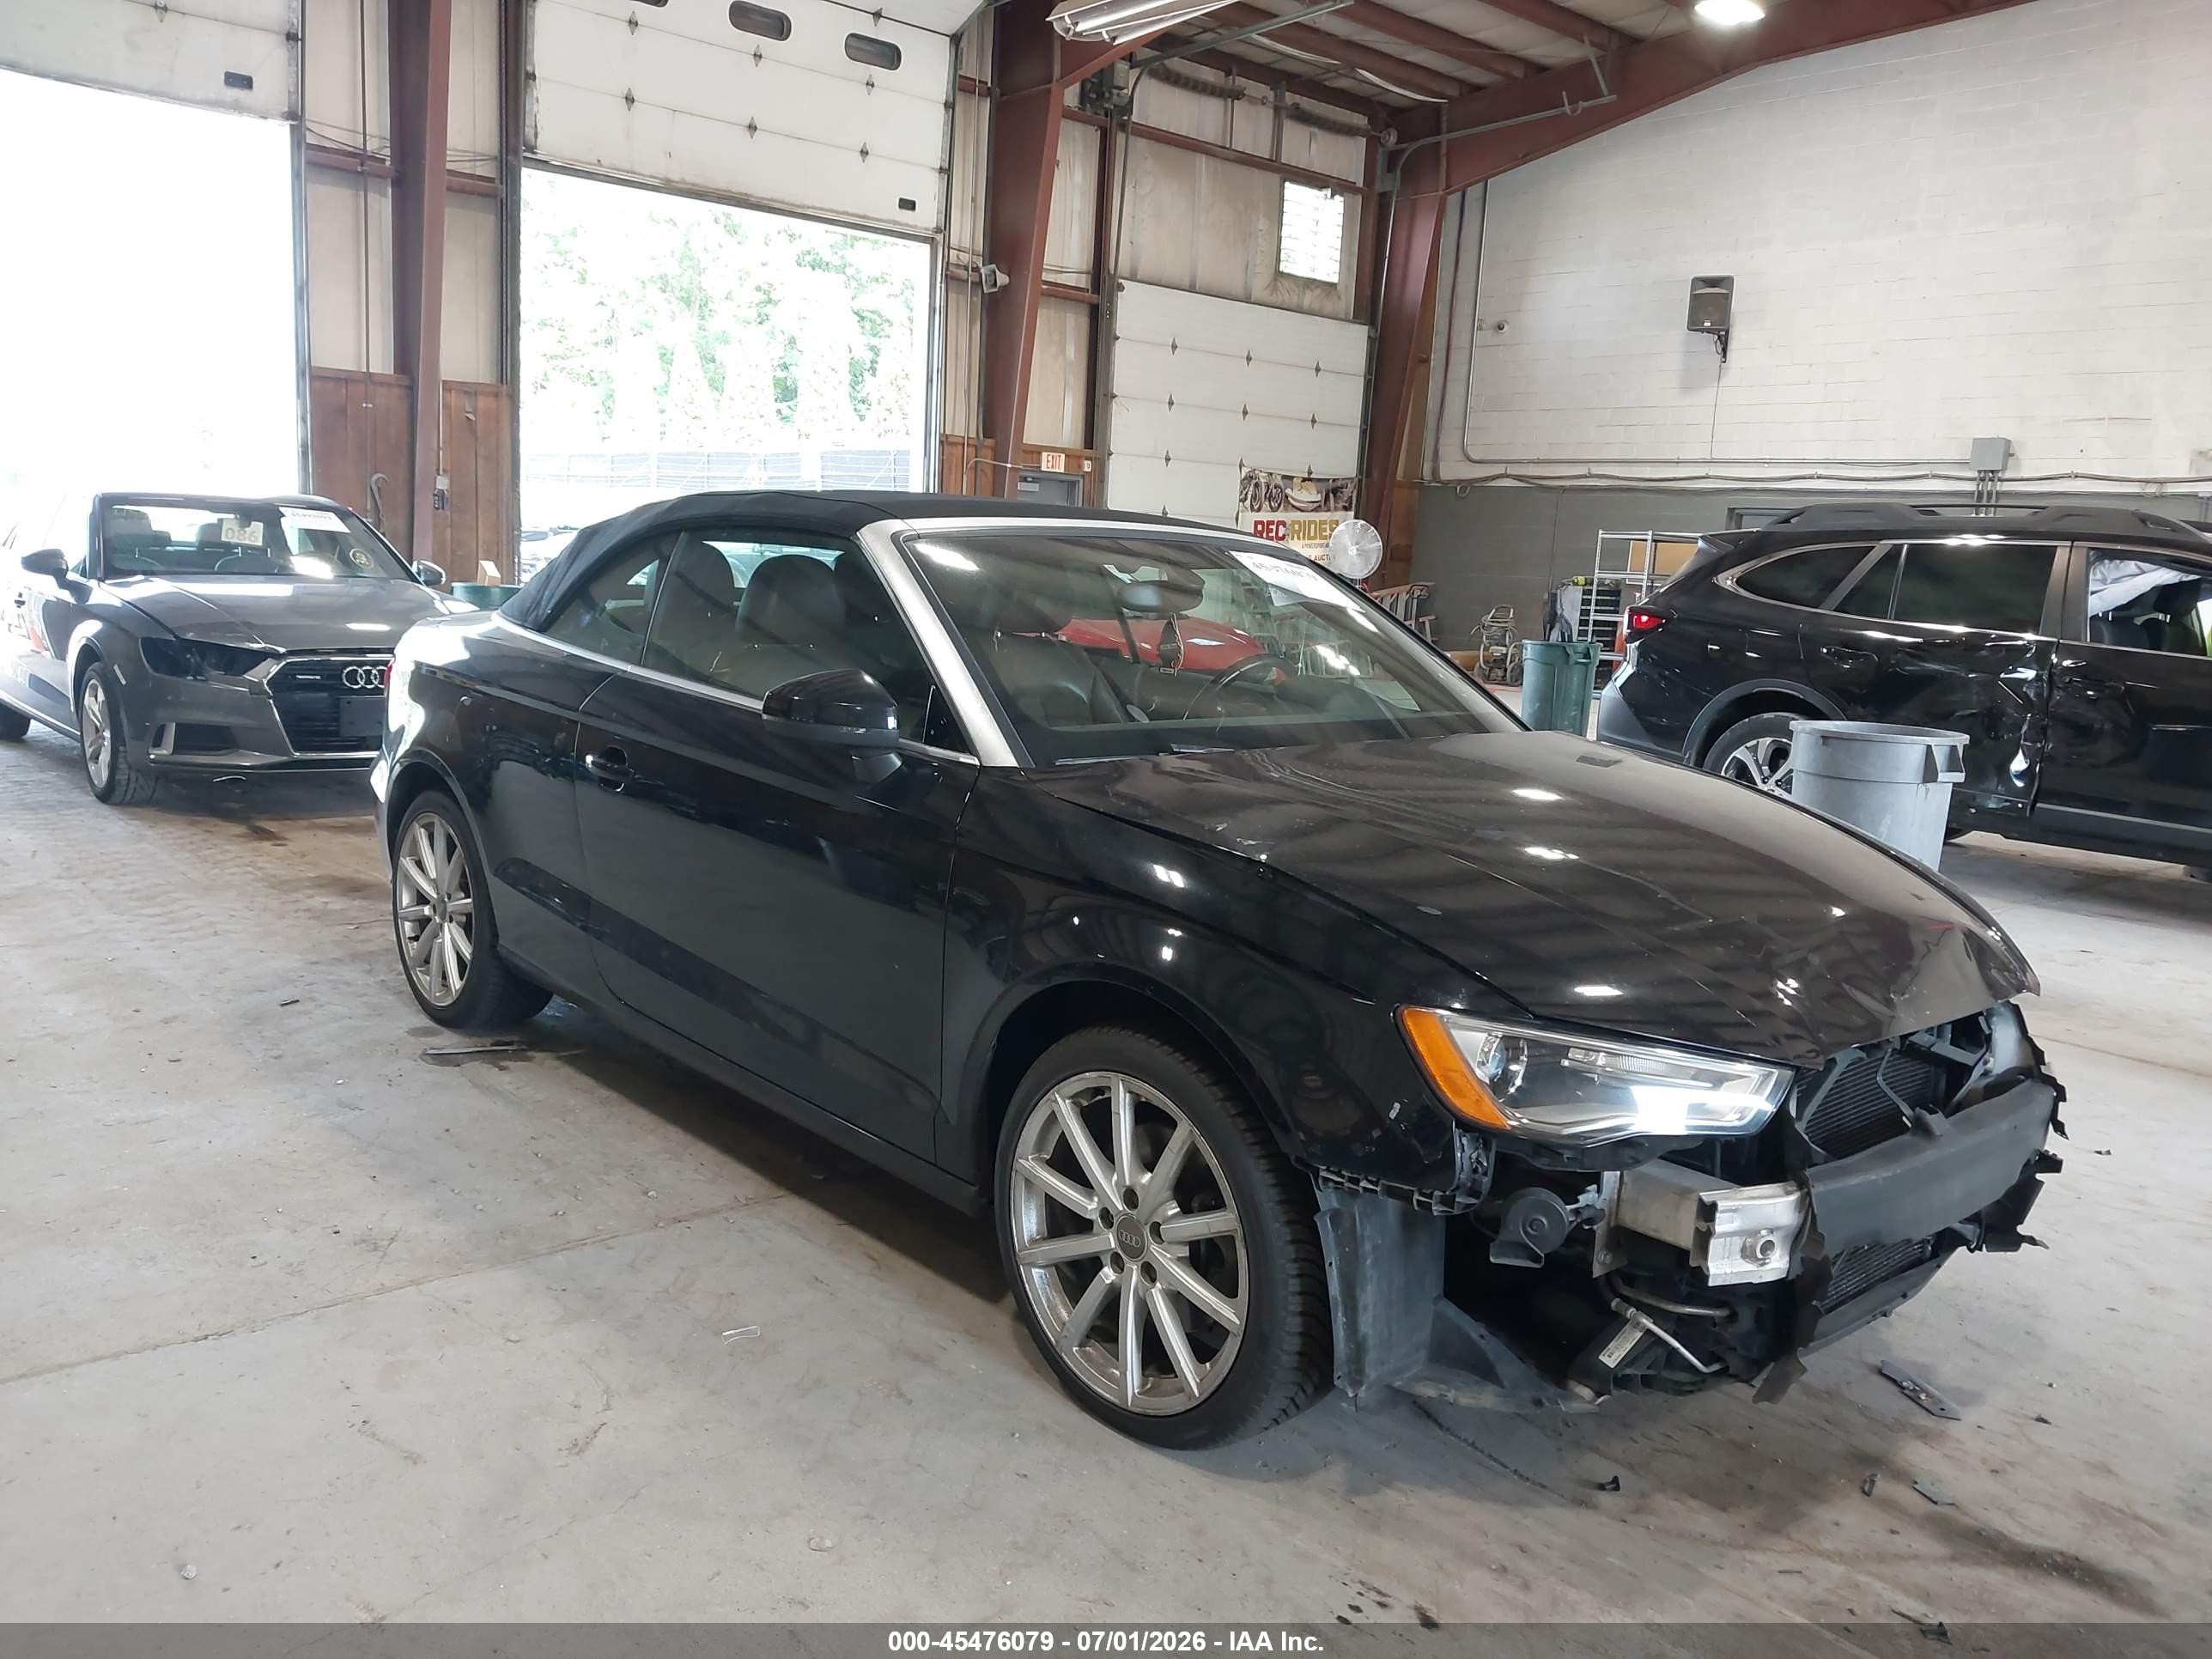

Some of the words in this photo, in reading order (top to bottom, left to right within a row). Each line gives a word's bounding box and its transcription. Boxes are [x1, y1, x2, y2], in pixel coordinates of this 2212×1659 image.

[1047, 453, 1062, 470] EXIT
[225, 527, 258, 544] 086
[1253, 520, 1287, 542] REC
[1291, 520, 1340, 541] RIDES
